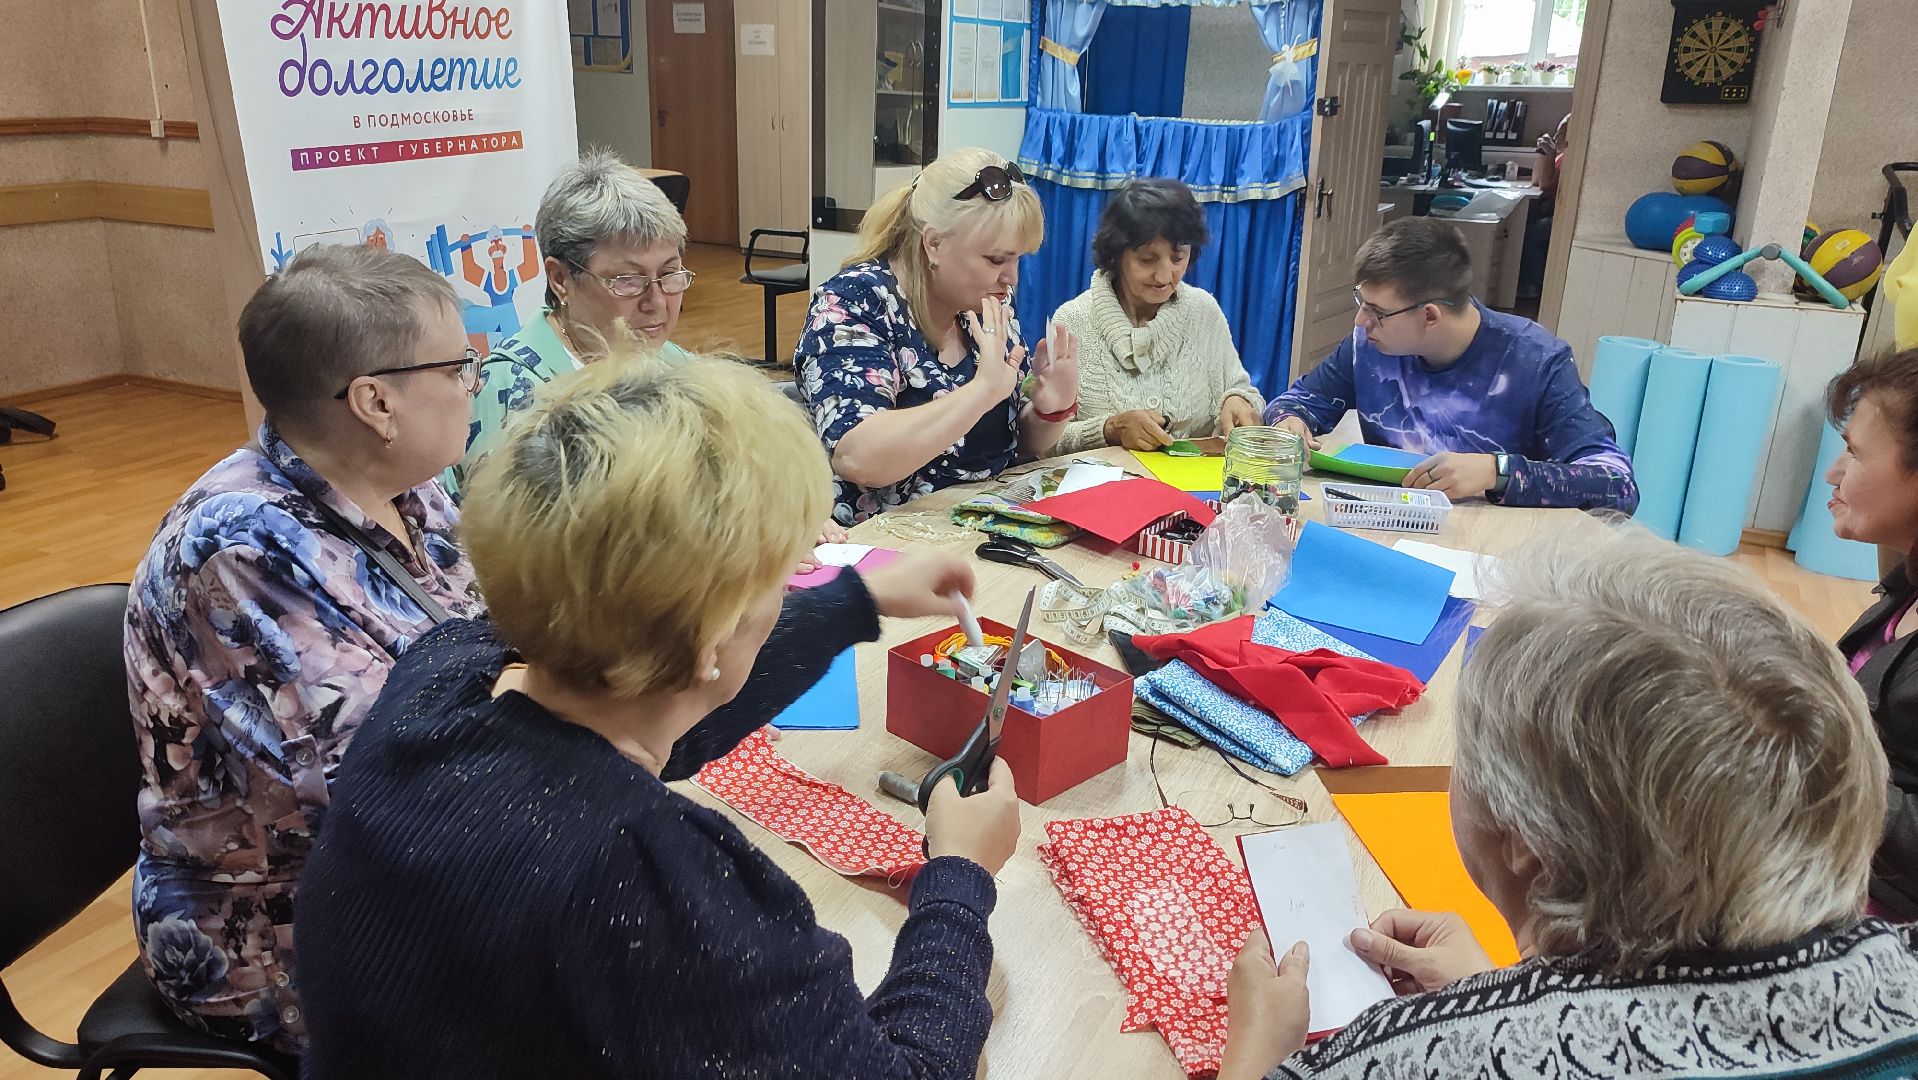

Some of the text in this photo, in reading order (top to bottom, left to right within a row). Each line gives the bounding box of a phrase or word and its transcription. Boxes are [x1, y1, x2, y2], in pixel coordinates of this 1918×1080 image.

[270, 0, 513, 40] Активное
[278, 32, 522, 97] долголетие
[353, 108, 475, 129] В ПОДМОСКОВЬЕ
[300, 134, 519, 165] ПРОЕКТ ГУБЕРНАТОРА
